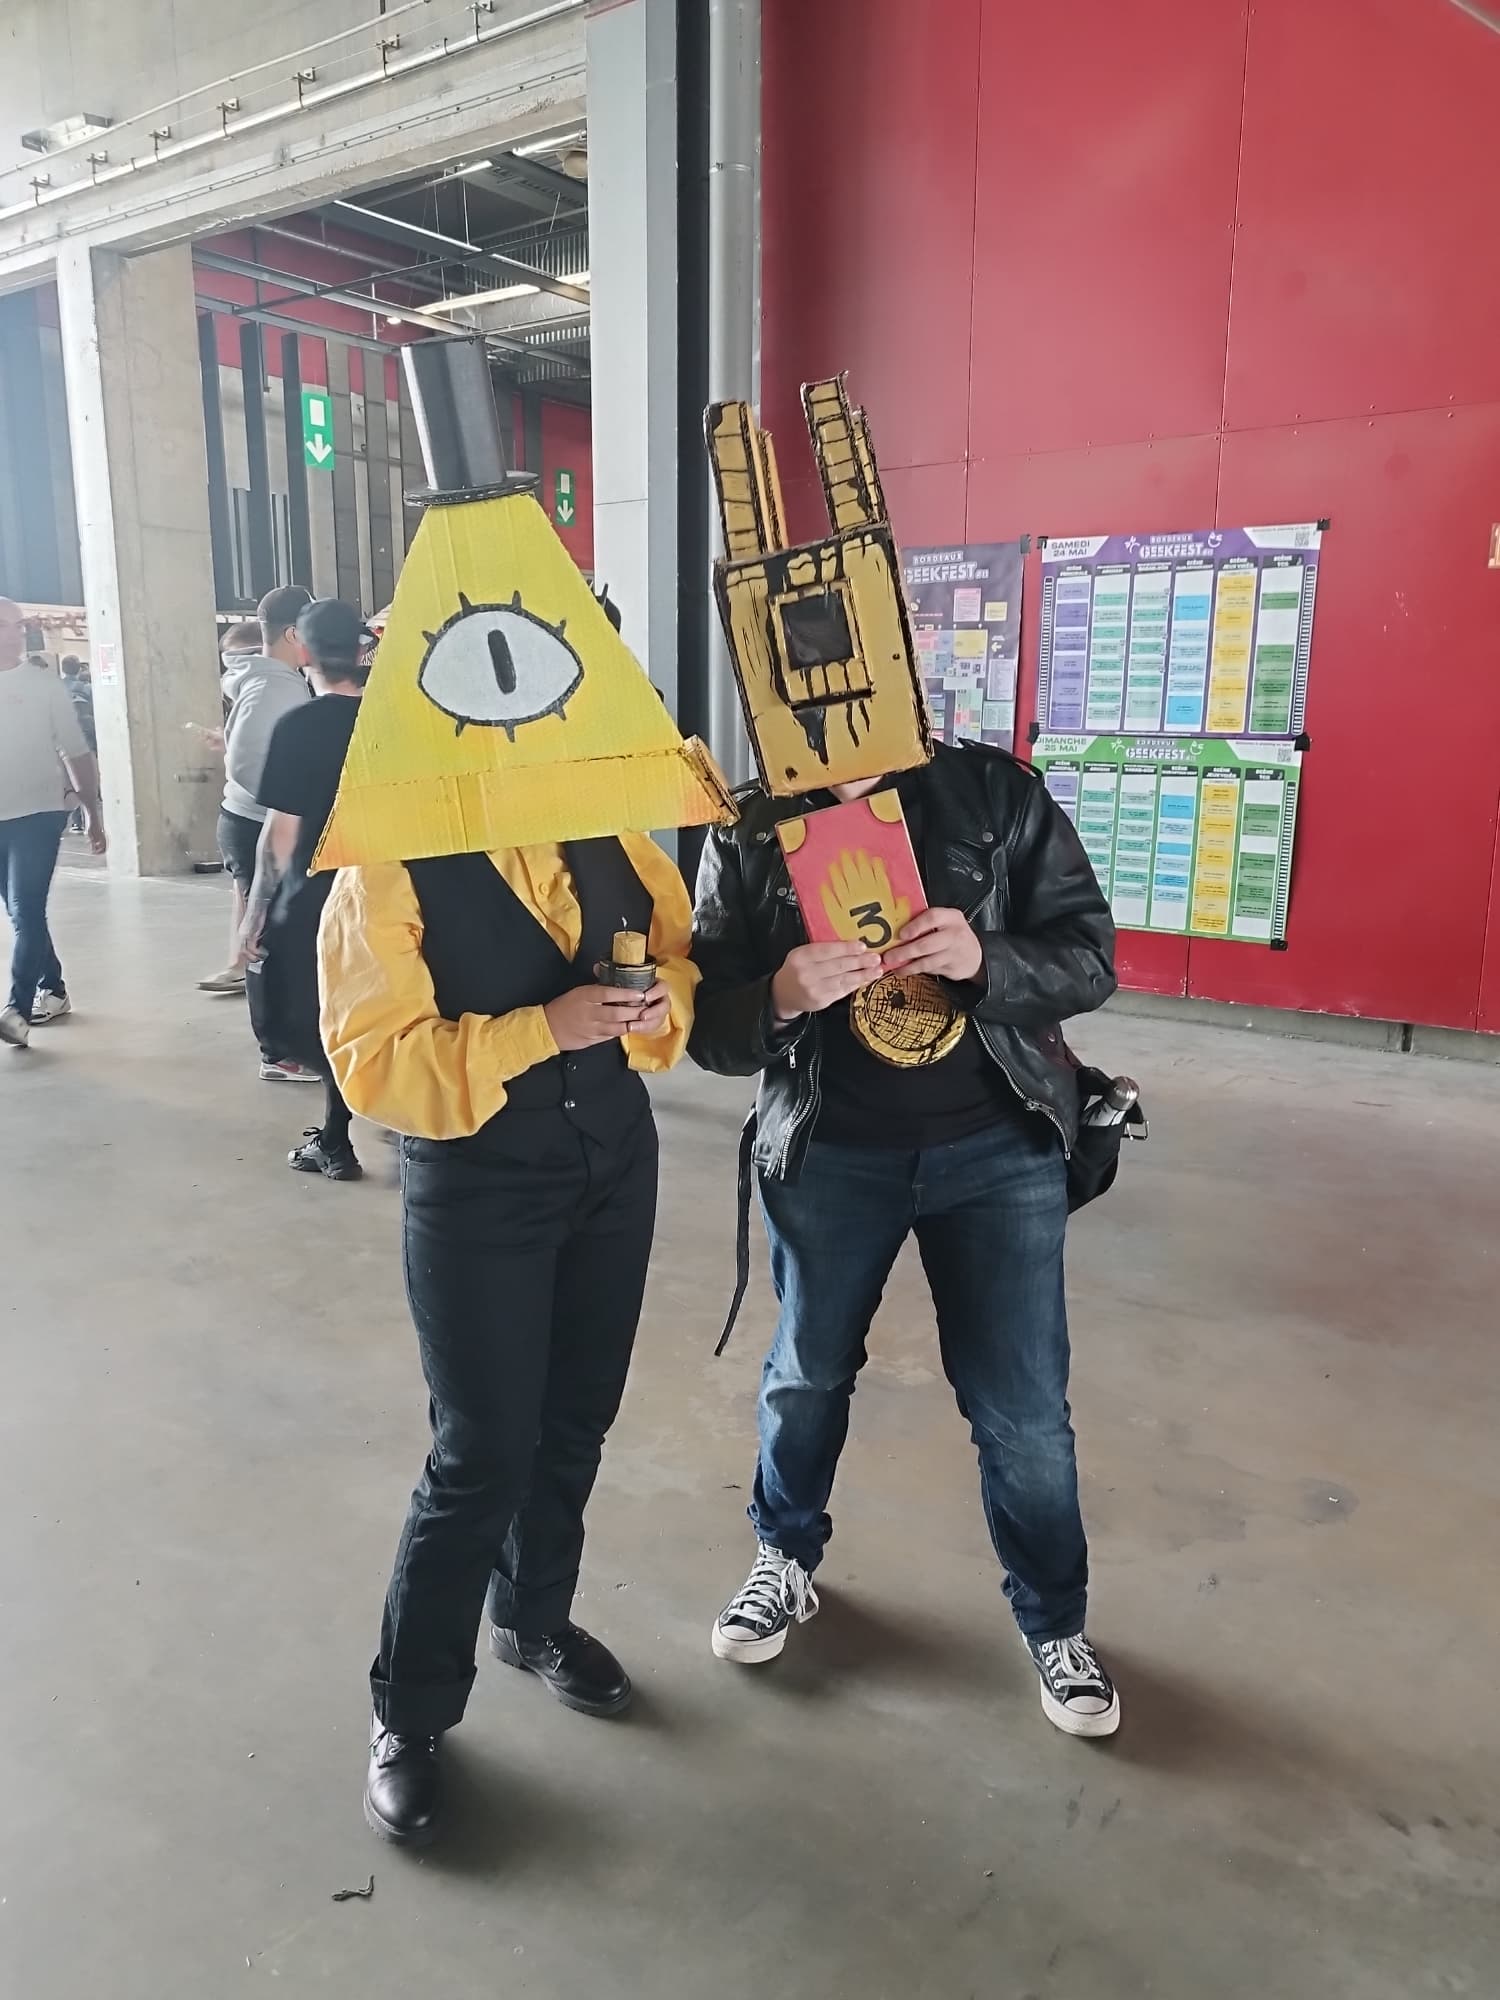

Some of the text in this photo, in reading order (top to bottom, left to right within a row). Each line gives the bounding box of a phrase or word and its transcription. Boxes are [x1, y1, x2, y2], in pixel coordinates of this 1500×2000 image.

[1051, 540, 1090, 549] SAMEDI
[1140, 542, 1204, 559] GEEKFEST
[913, 551, 964, 565] BORDEAUX
[1126, 748, 1186, 760] GEEKFEST
[849, 901, 892, 949] 3
